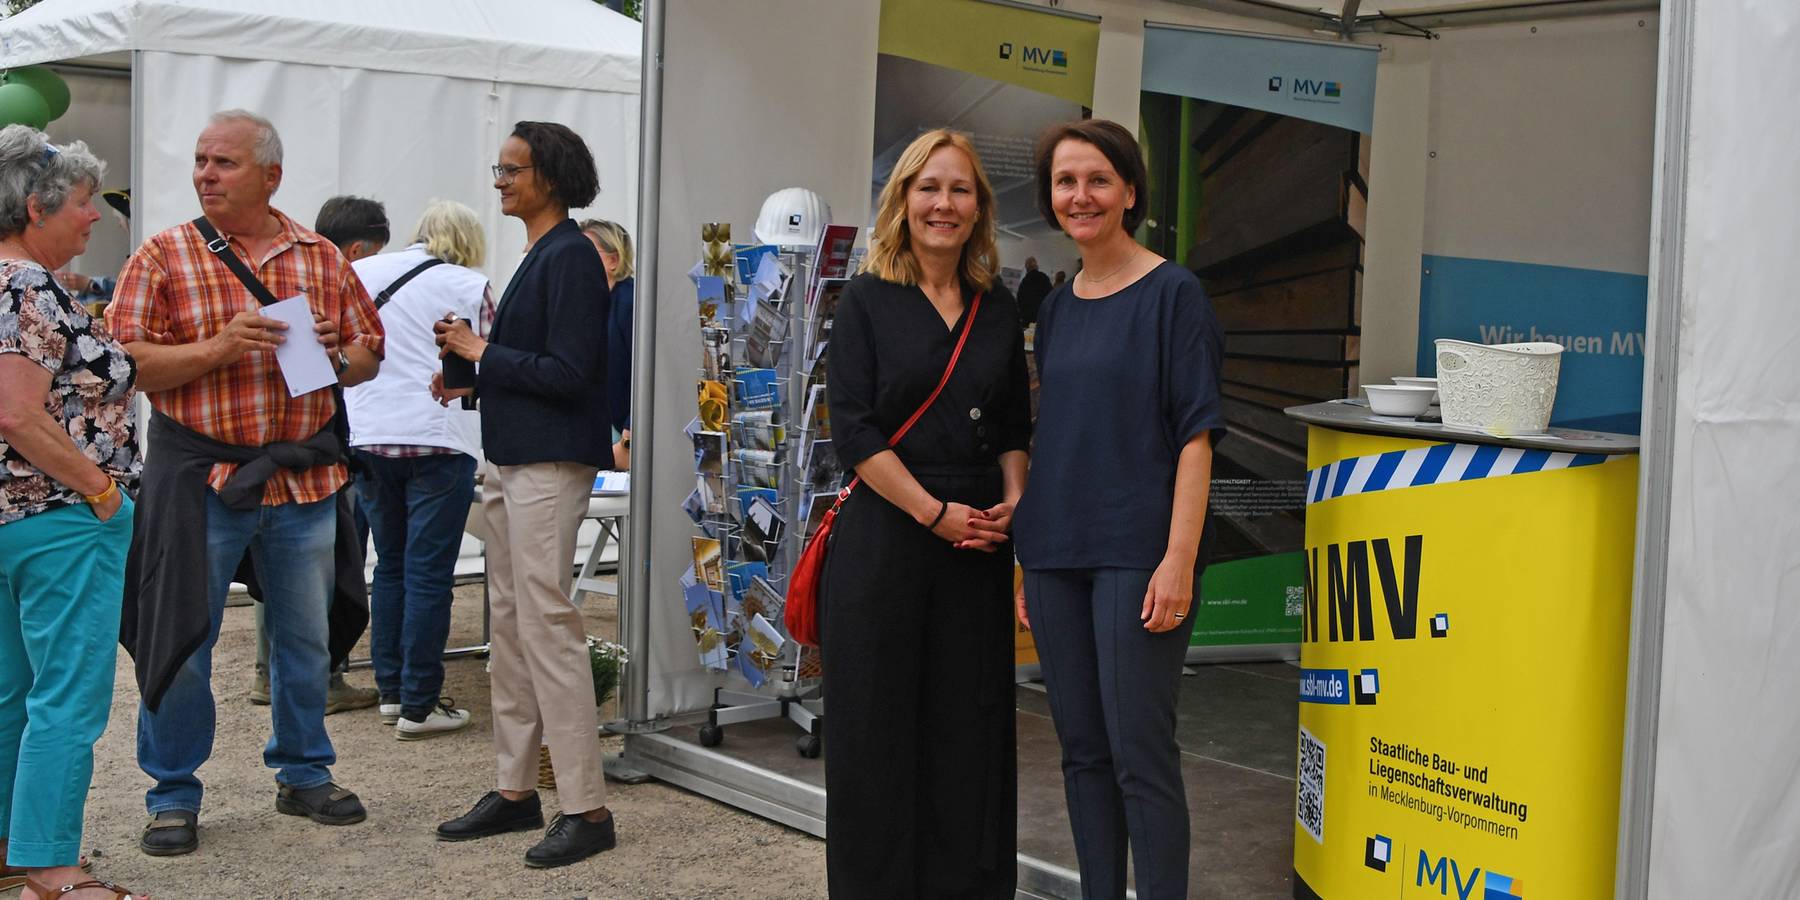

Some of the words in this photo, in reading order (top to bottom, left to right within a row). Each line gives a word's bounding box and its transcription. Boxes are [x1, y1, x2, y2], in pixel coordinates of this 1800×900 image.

[1023, 46, 1052, 65] MV
[1293, 78, 1323, 96] MV
[1479, 325, 1524, 345] Wir
[1609, 331, 1646, 356] M
[1369, 736, 1429, 768] Staatliche
[1432, 753, 1460, 775] Bau-
[1463, 766, 1488, 784] und
[1368, 781, 1378, 798] in
[1380, 784, 1519, 840] Mecklenburg-Vorpommern
[1369, 758, 1528, 822] Liegenschaftsverwaltung
[1416, 848, 1481, 900] MV
